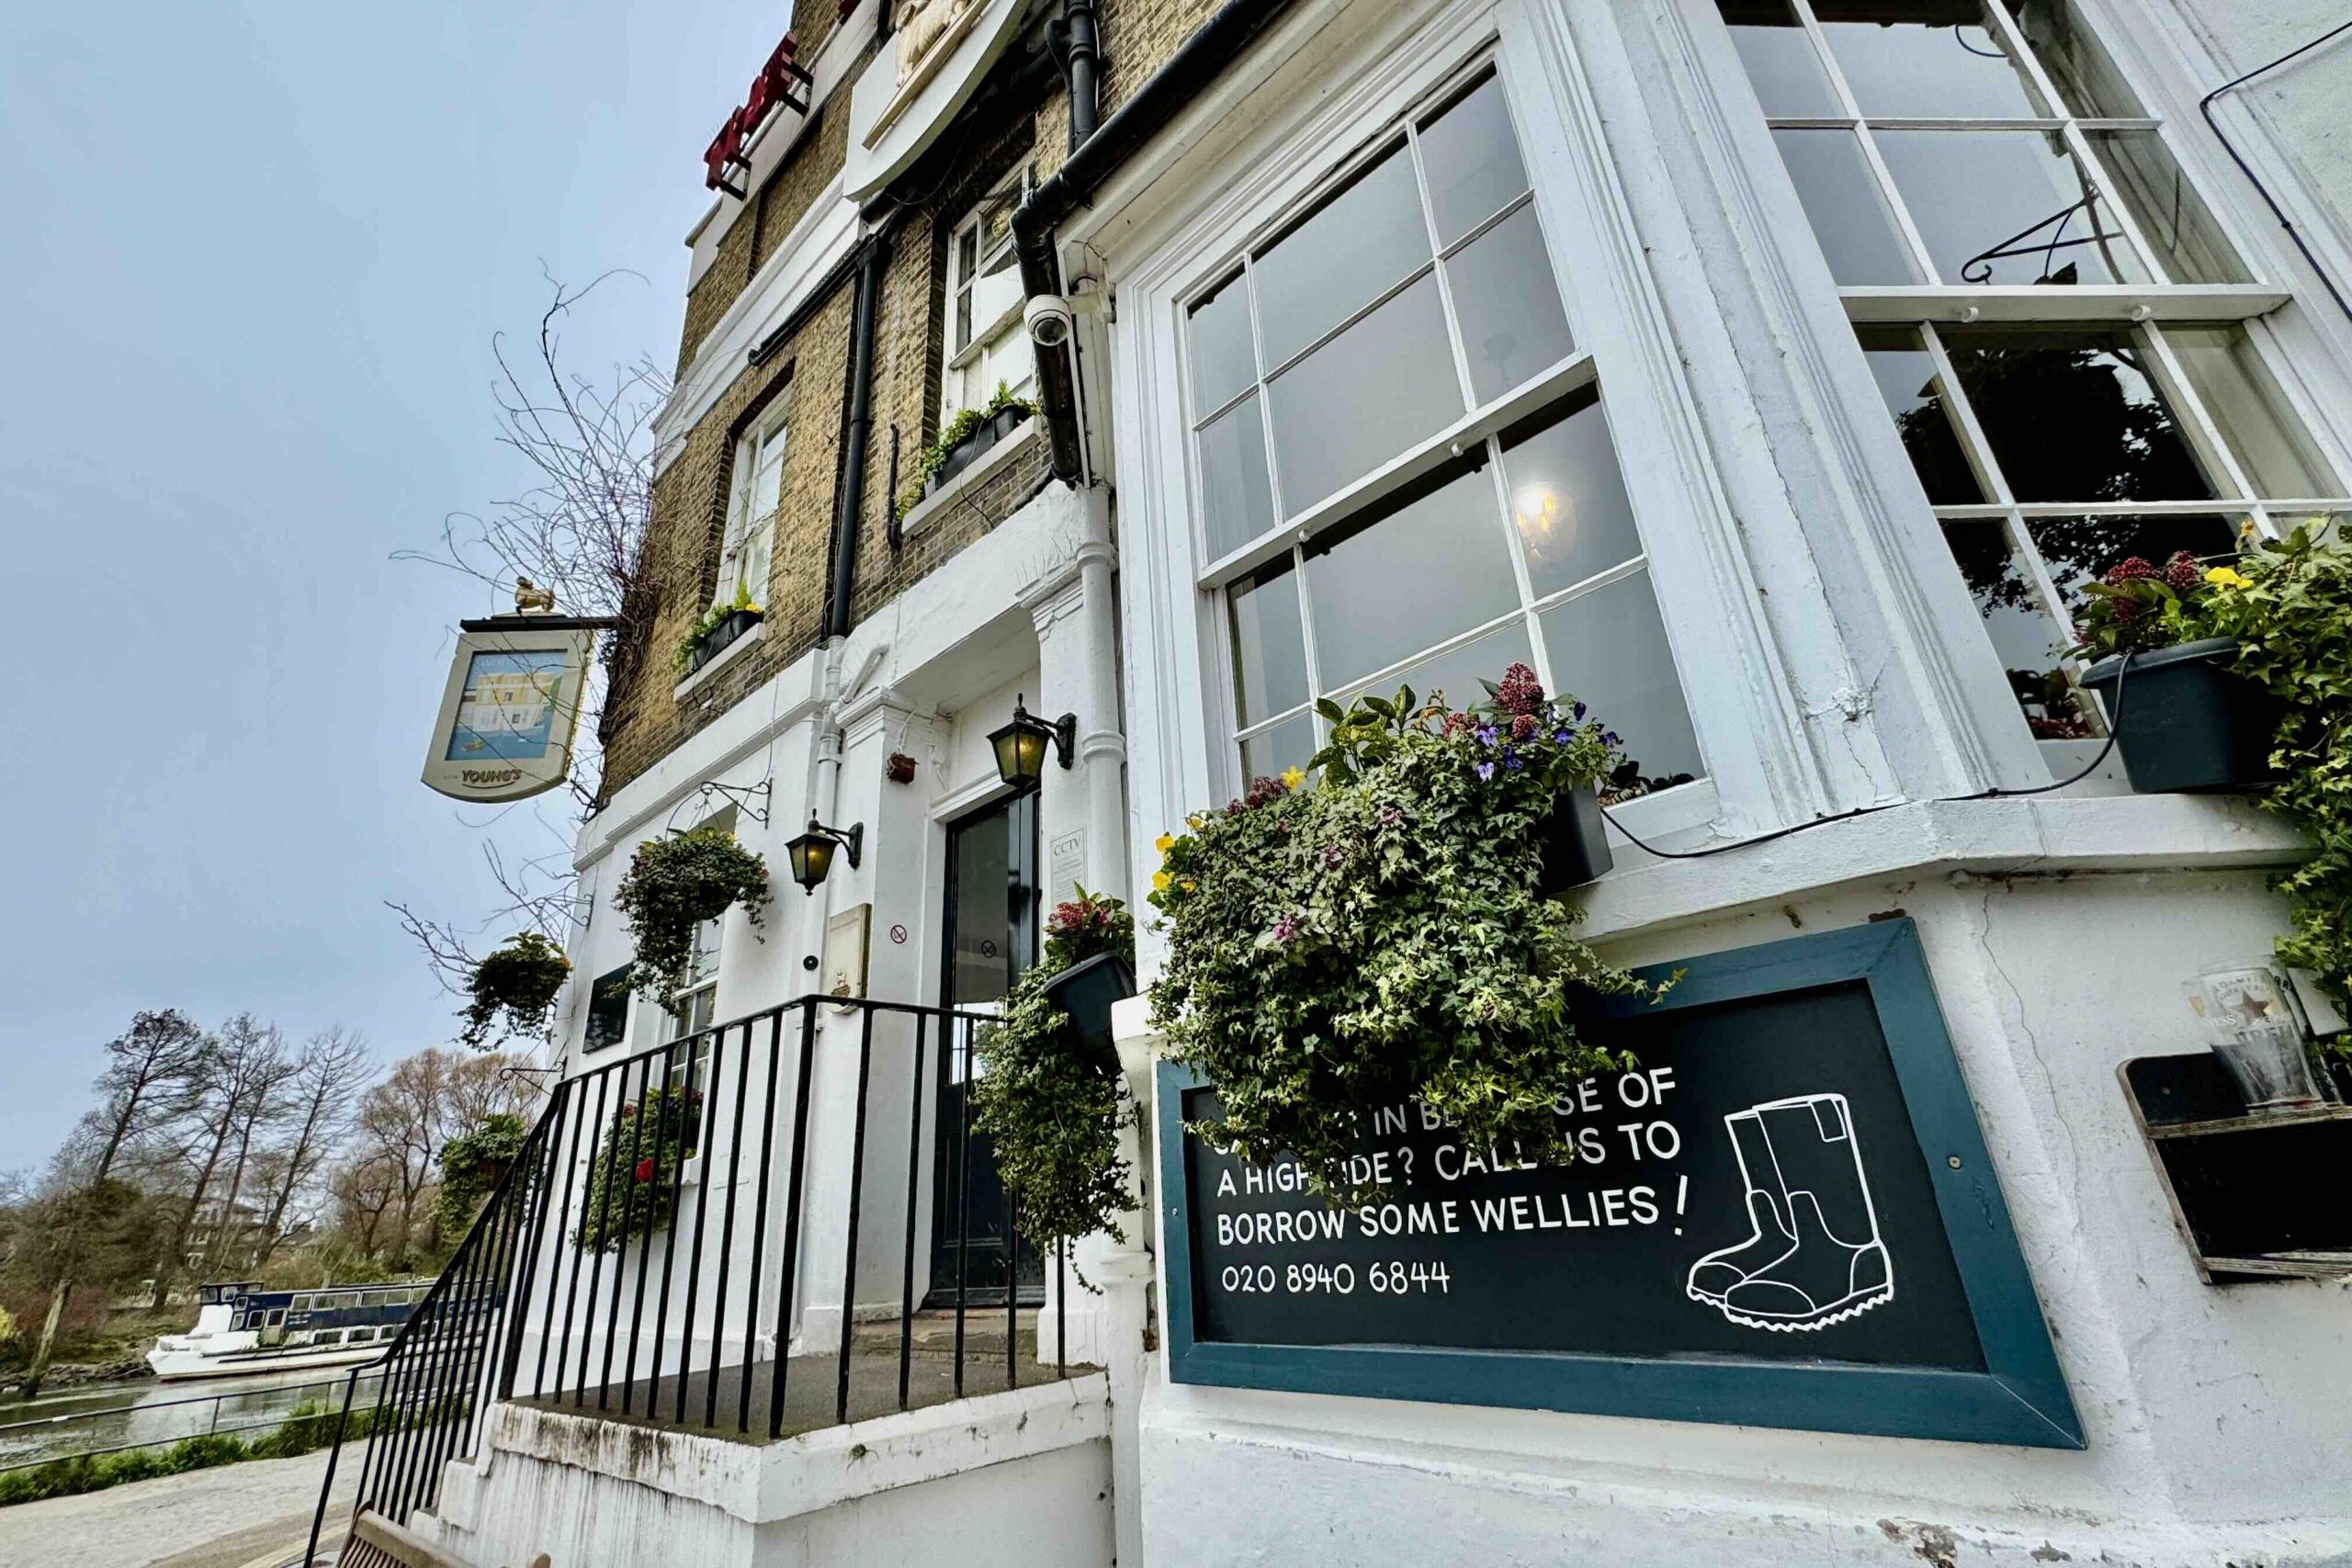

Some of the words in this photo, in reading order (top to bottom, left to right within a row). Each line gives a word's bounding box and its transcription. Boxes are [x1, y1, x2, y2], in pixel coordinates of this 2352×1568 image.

[461, 768, 522, 784] YOUNG'S
[1053, 835, 1081, 856] CCTV
[1374, 1103, 1408, 1136] IN
[1618, 1066, 1676, 1108] OF
[1216, 1168, 1238, 1198] A
[1323, 1145, 1415, 1190] IDE?
[1434, 1139, 1538, 1182] CALL
[1617, 1120, 1680, 1161] TO
[1216, 1209, 1346, 1247] BORROW
[1360, 1201, 1460, 1237] SOME
[1221, 1264, 1276, 1293] 020
[1286, 1262, 1356, 1294] 8940
[1369, 1261, 1451, 1295] 6844
